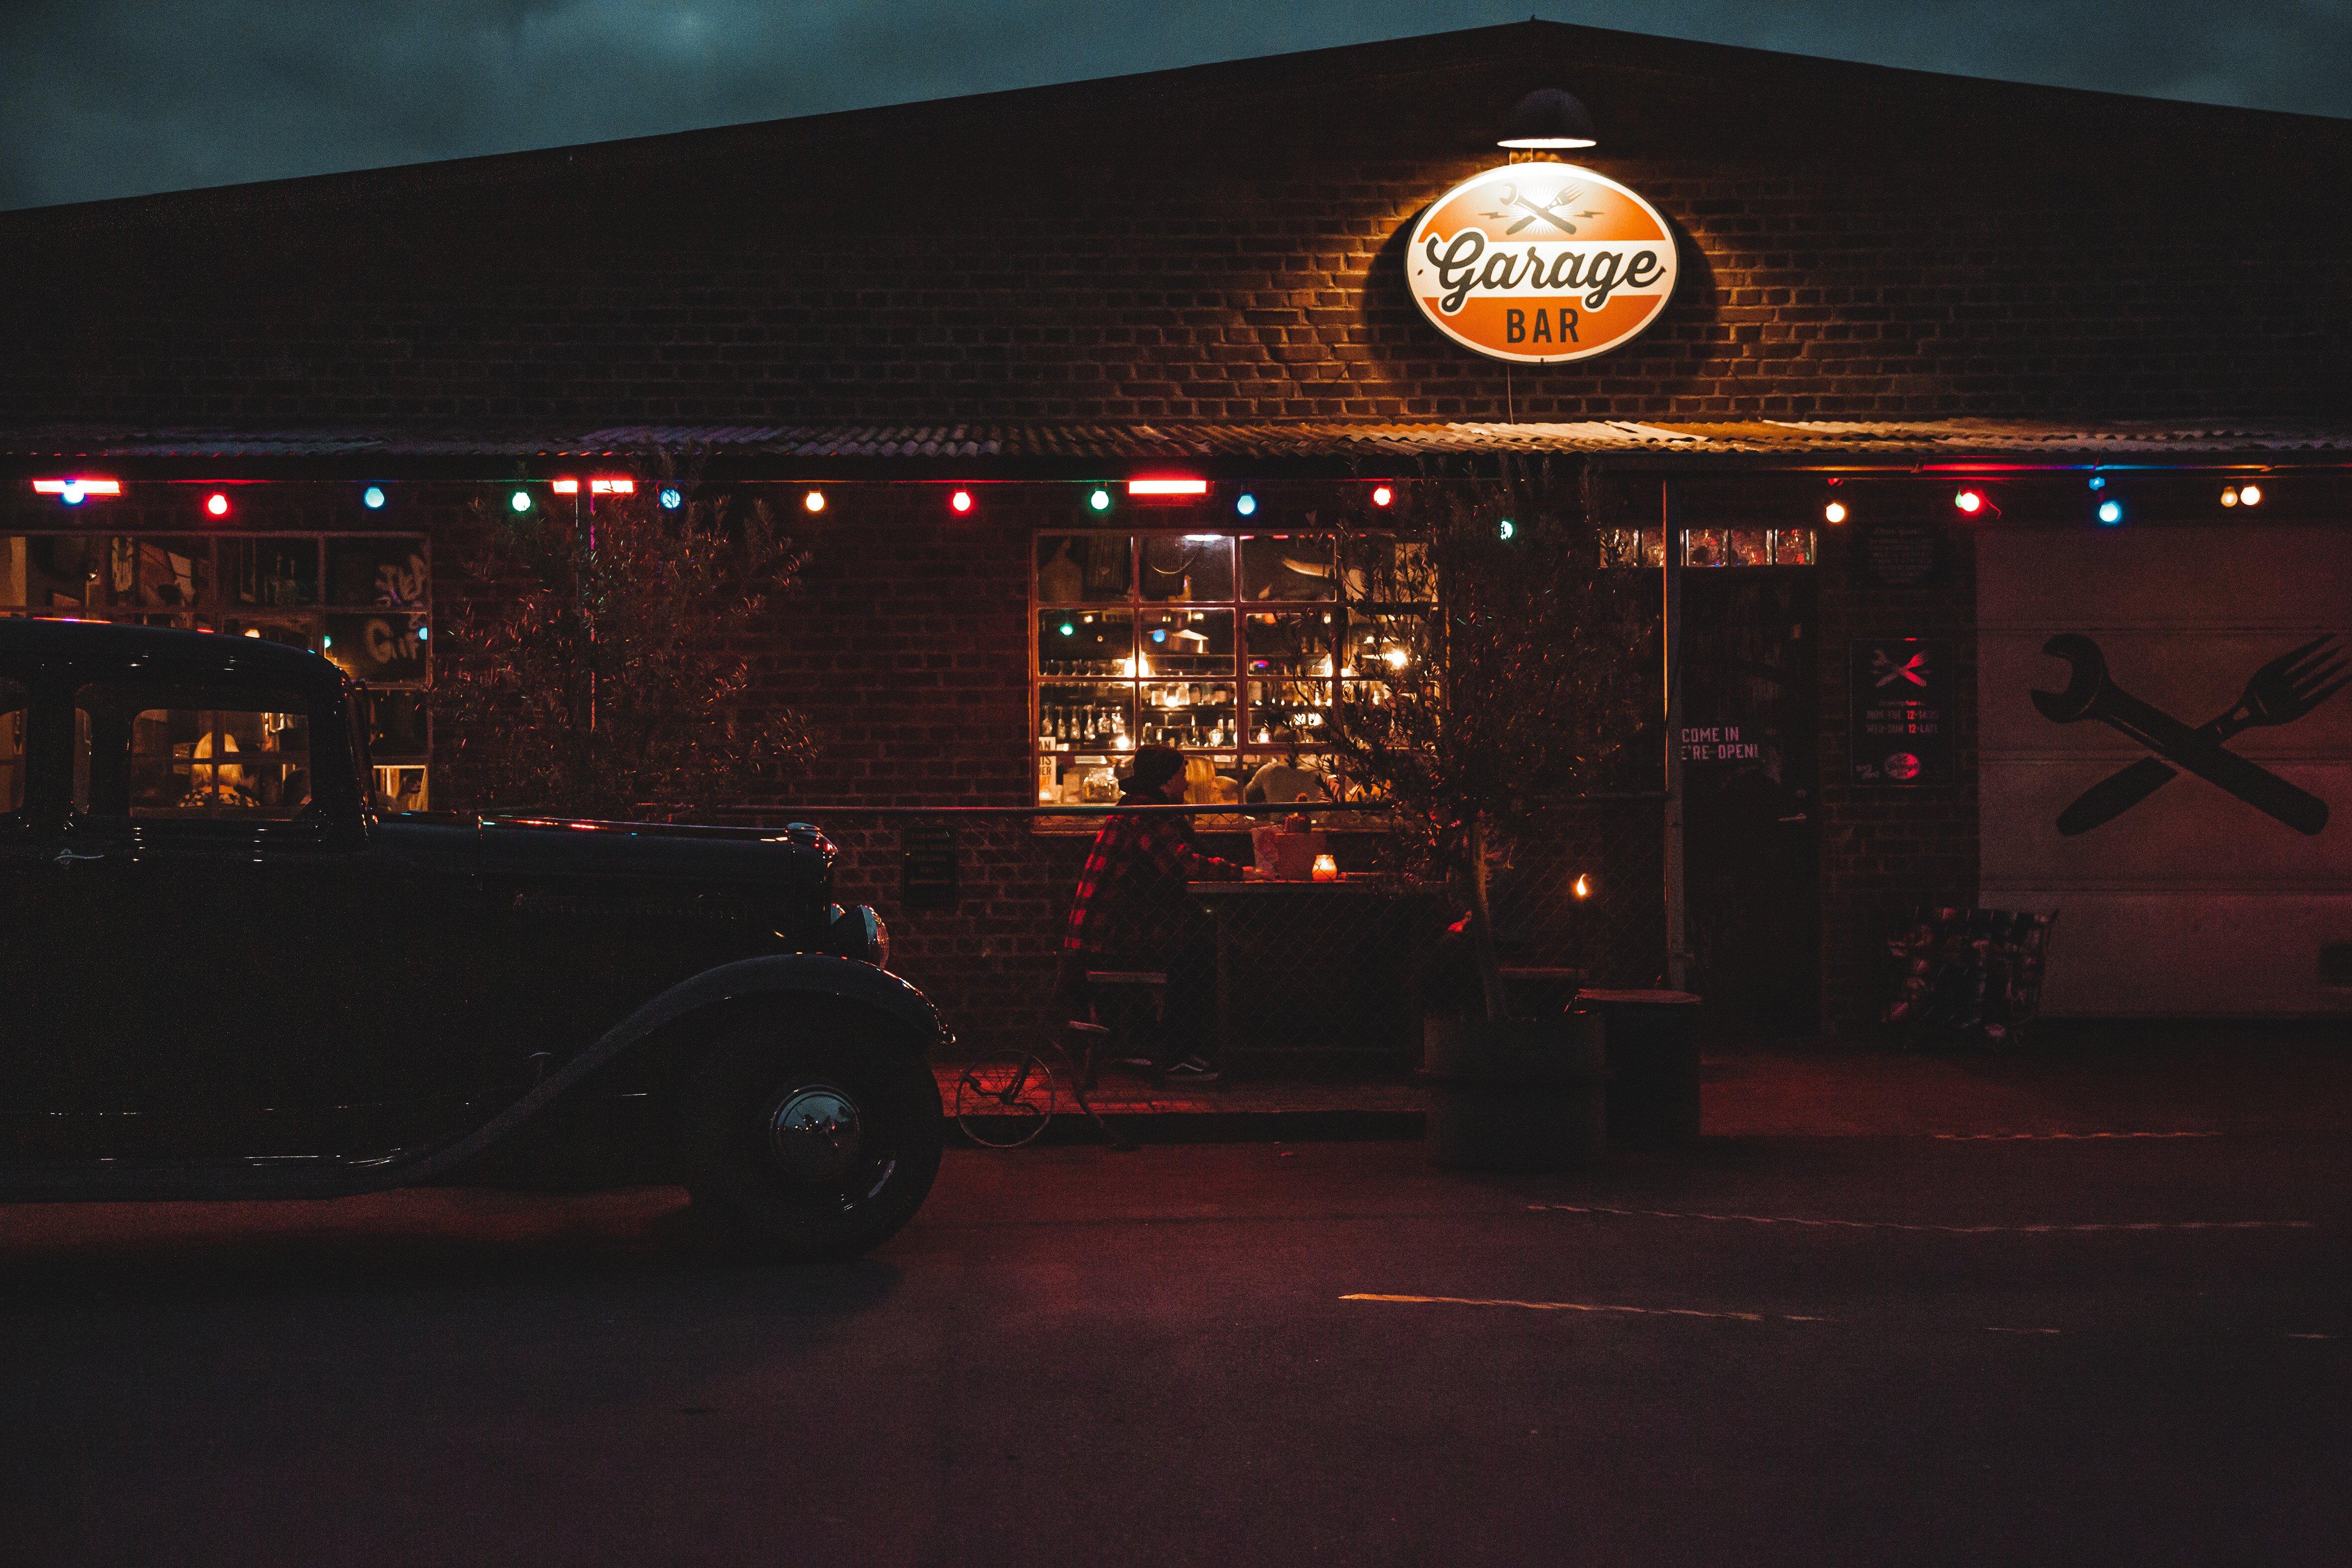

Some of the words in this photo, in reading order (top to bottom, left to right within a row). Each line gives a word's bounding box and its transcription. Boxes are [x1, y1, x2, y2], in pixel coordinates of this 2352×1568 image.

[1426, 231, 1665, 313] Garage
[1507, 308, 1579, 343] BAR
[1681, 727, 1720, 743] COME
[1725, 726, 1739, 742] IN
